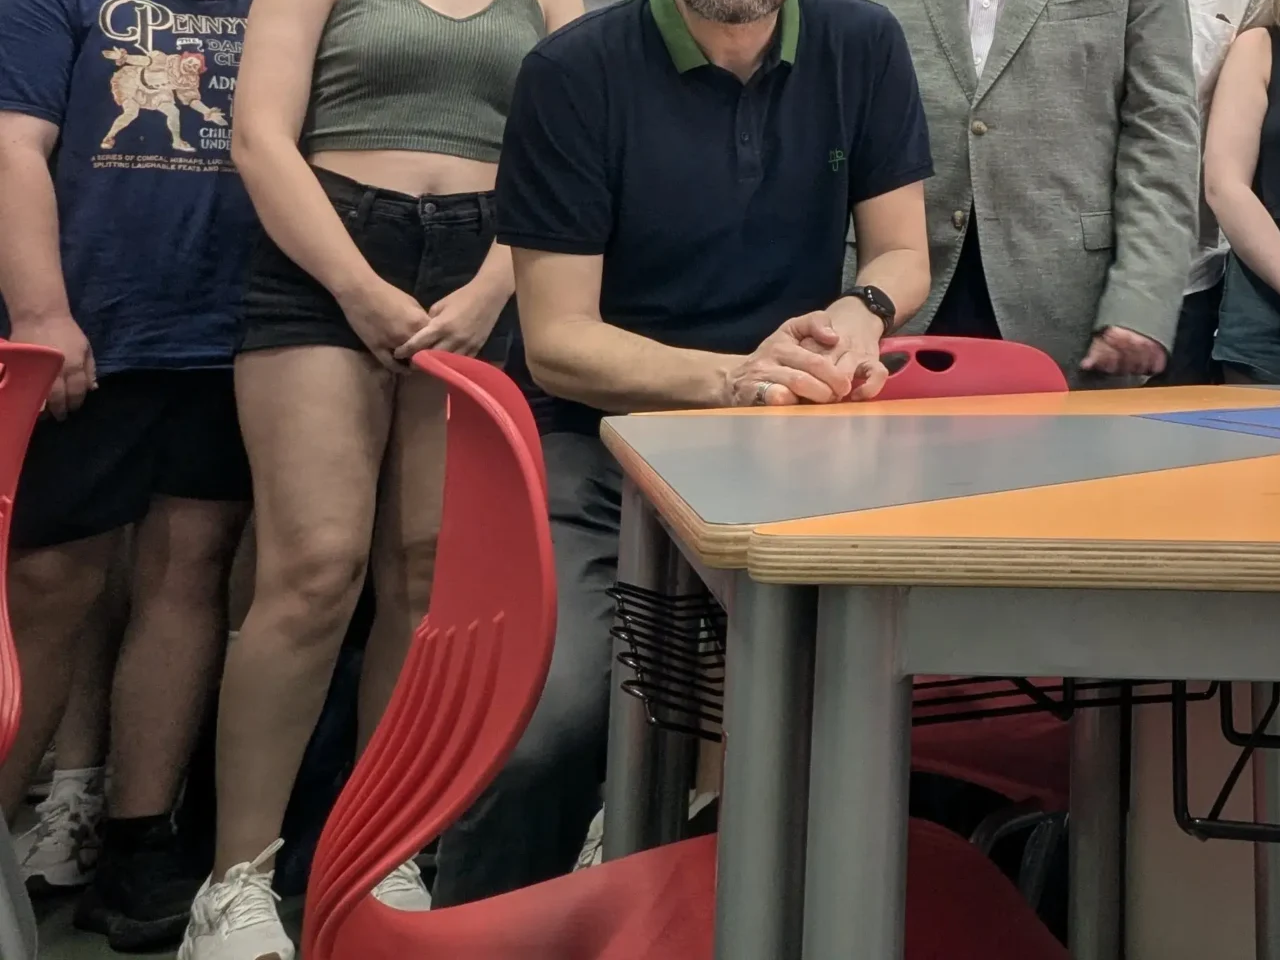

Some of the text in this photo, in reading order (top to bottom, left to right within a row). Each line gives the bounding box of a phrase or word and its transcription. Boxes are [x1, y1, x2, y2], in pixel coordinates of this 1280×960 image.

[214, 52, 241, 67] CL
[200, 138, 232, 151] UNDE
[136, 154, 169, 163] COMICAL
[131, 162, 176, 171] LAUGHABLE
